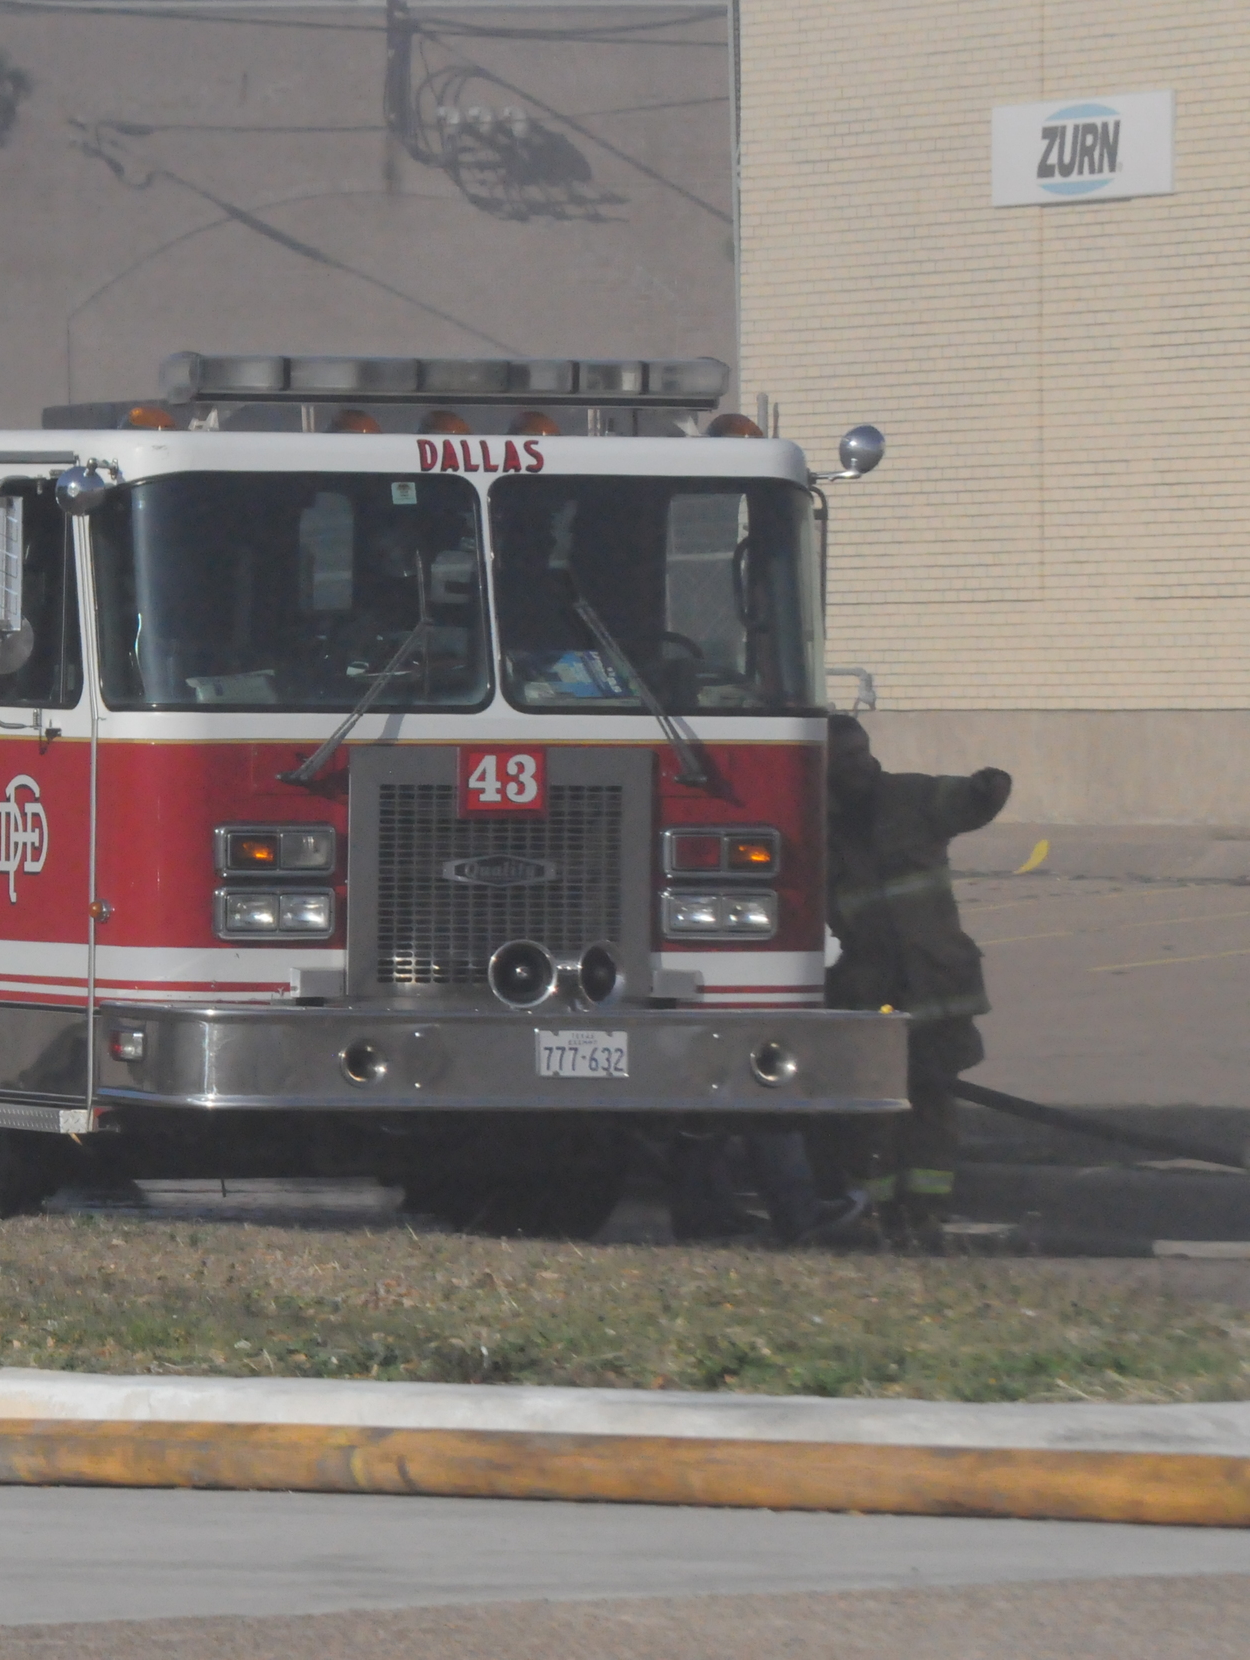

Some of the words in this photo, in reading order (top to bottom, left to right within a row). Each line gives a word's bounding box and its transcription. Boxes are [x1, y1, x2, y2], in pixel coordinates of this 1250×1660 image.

[1036, 120, 1121, 179] ZURN
[417, 439, 544, 473] DALLAS
[468, 754, 538, 803] 43
